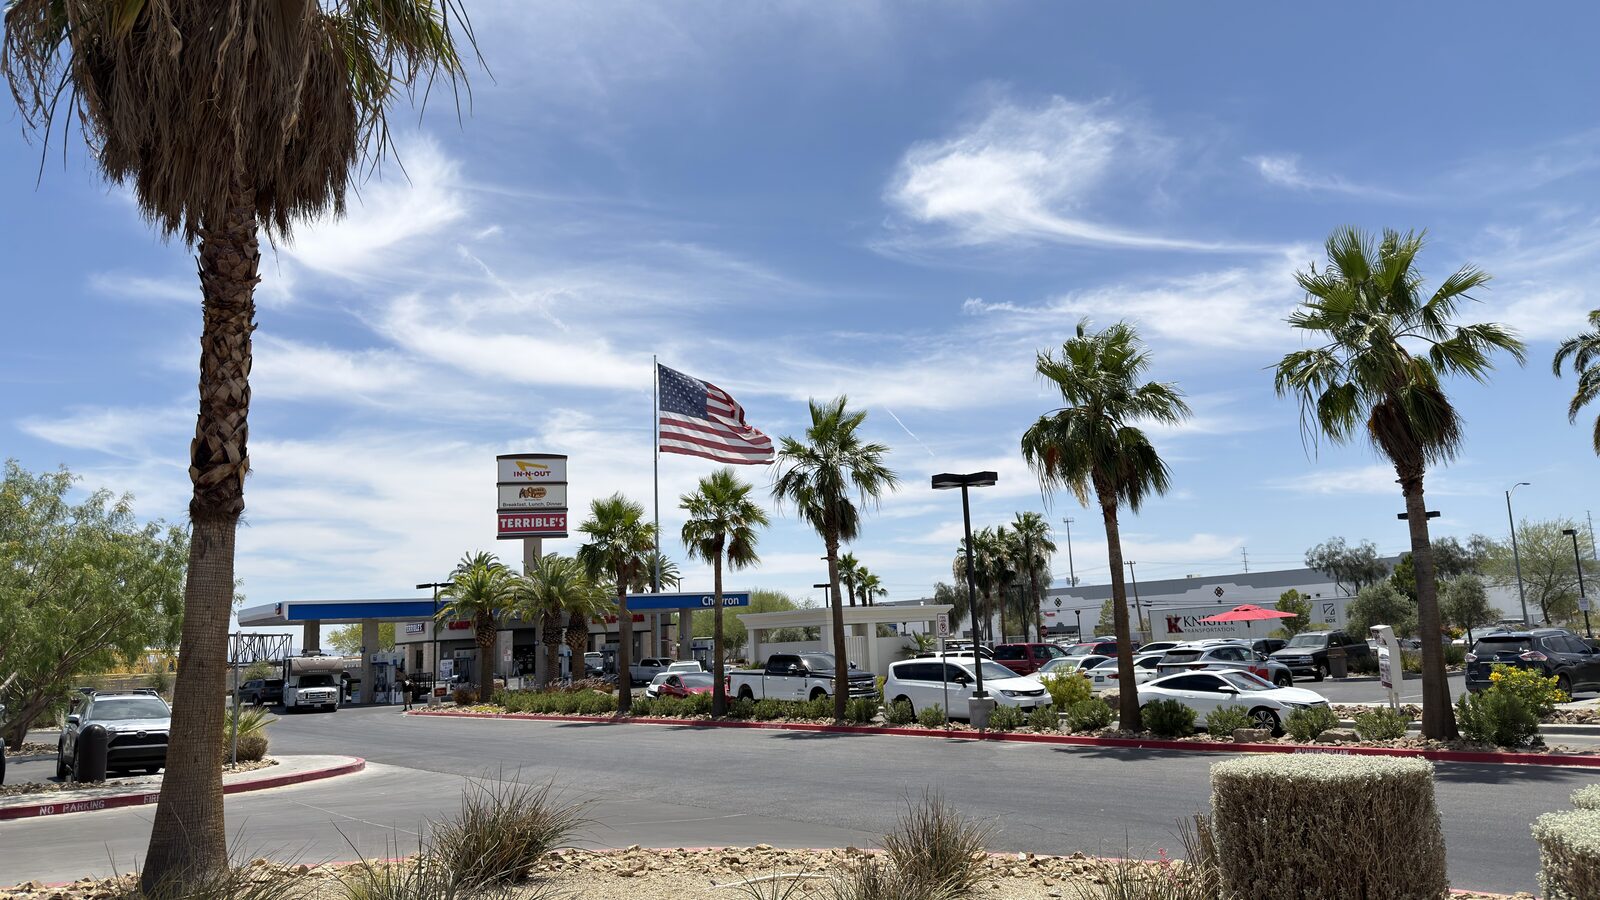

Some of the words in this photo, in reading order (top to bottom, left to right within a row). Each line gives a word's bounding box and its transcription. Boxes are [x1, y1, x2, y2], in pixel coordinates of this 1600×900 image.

[500, 517, 565, 528] TERRIBLE'S
[702, 596, 739, 606] Chron
[39, 806, 55, 815] NO
[62, 800, 105, 813] PARKING
